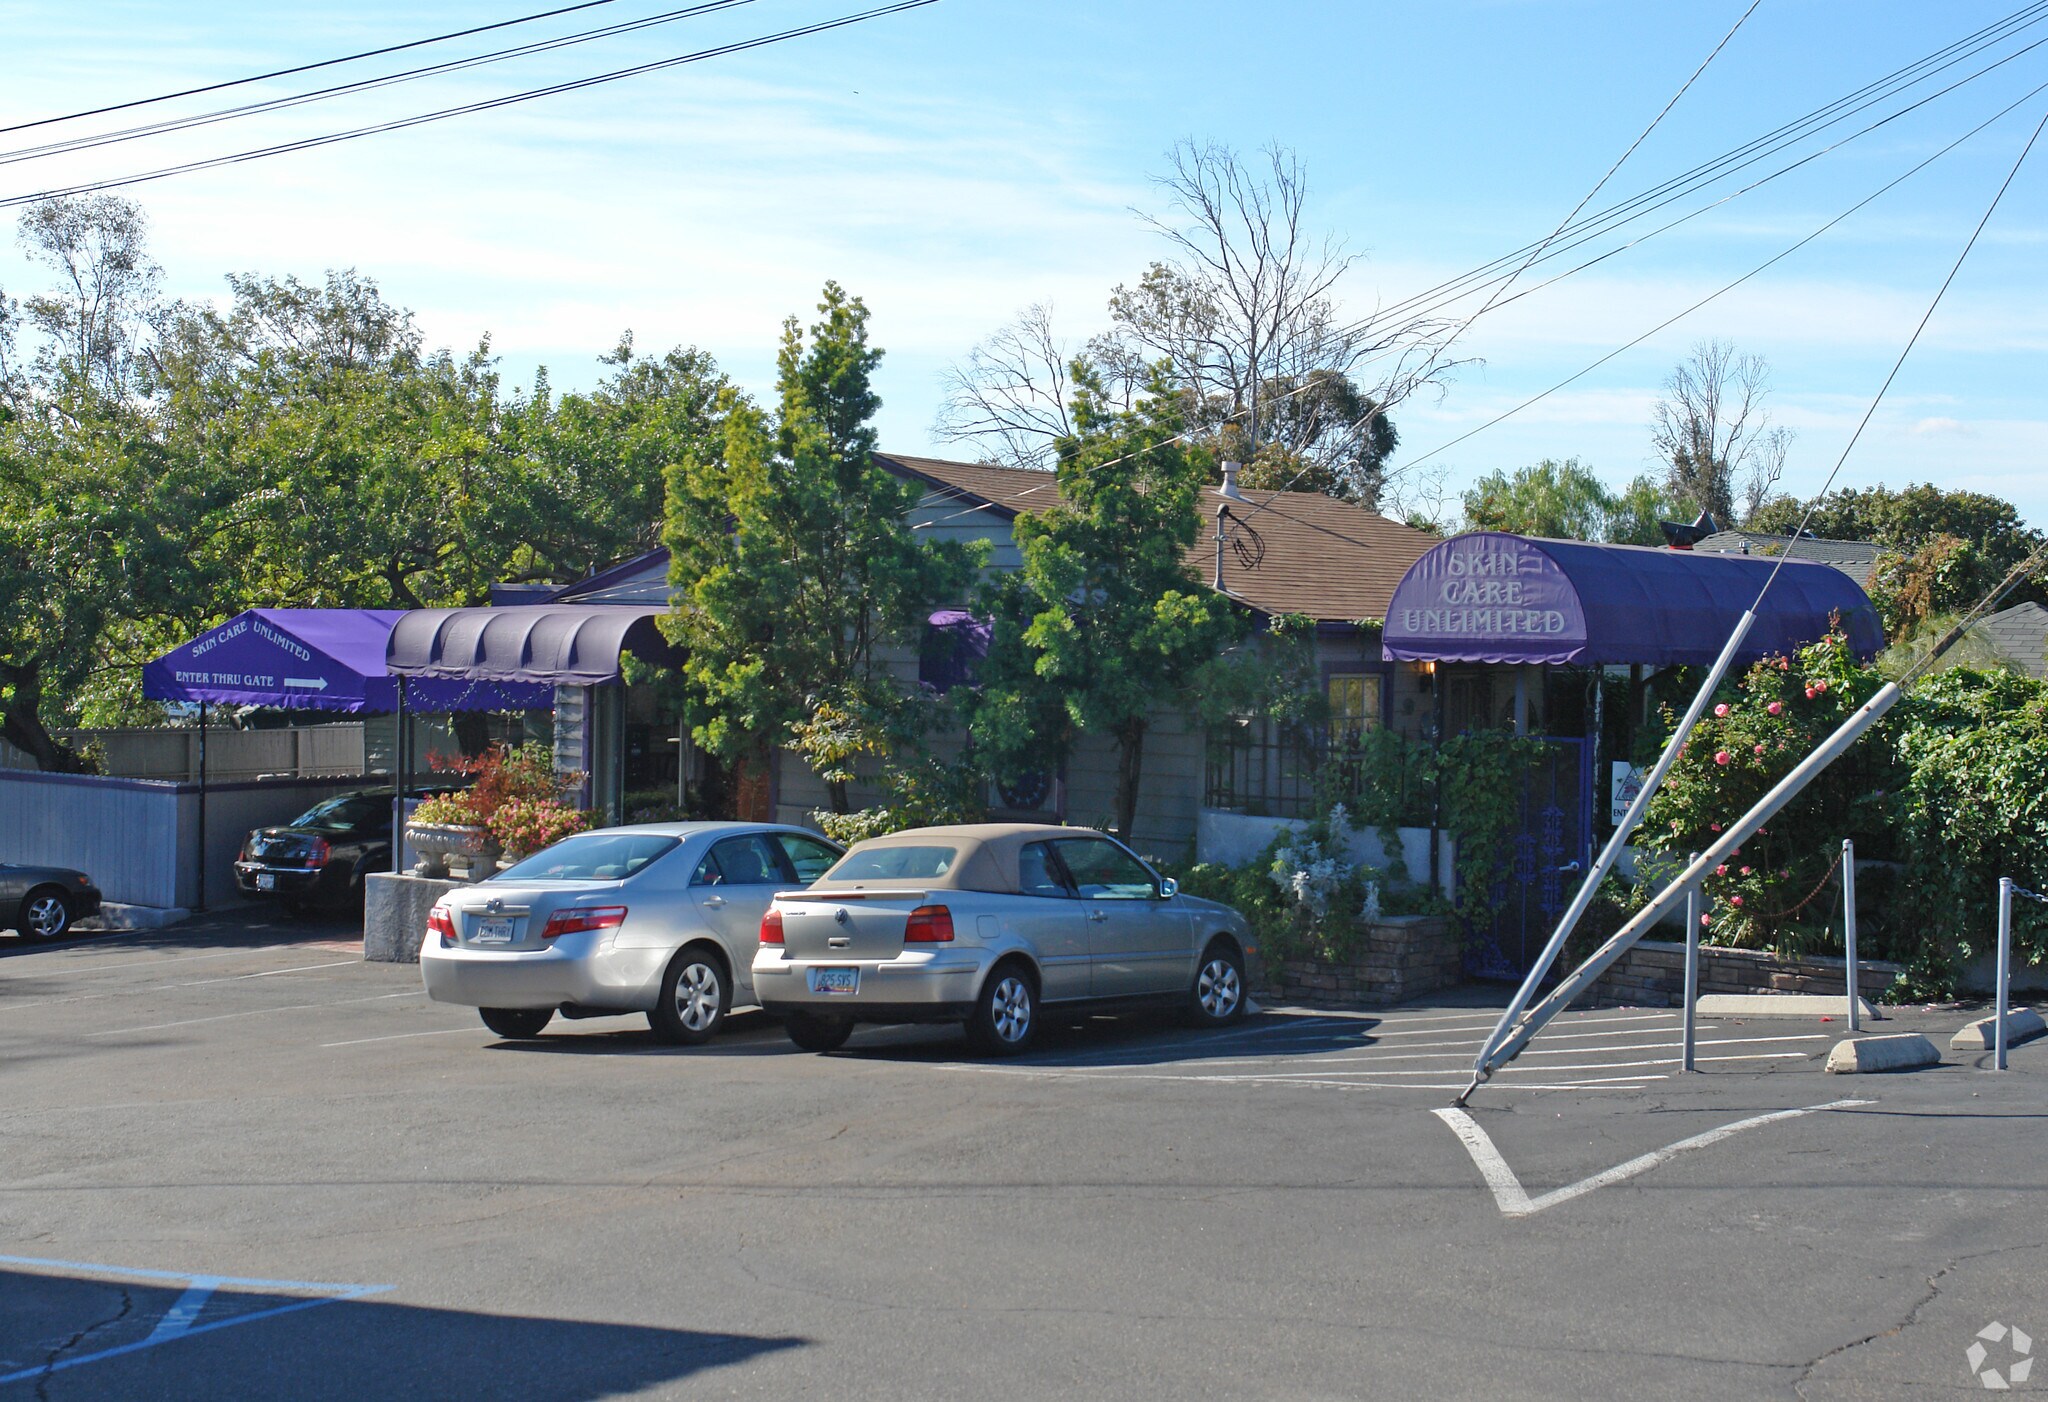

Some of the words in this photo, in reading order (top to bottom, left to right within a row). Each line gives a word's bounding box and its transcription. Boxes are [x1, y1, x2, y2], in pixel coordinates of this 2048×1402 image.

[1451, 553, 1518, 576] SKIN
[1443, 581, 1523, 605] CARE
[1404, 609, 1565, 633] UNLIMITED
[192, 636, 217, 658] SKIN
[218, 621, 248, 643] CARE
[253, 620, 311, 662] UNLIMITED
[175, 670, 209, 684] ENTER
[212, 672, 241, 685] THRU
[244, 674, 275, 687] GATE
